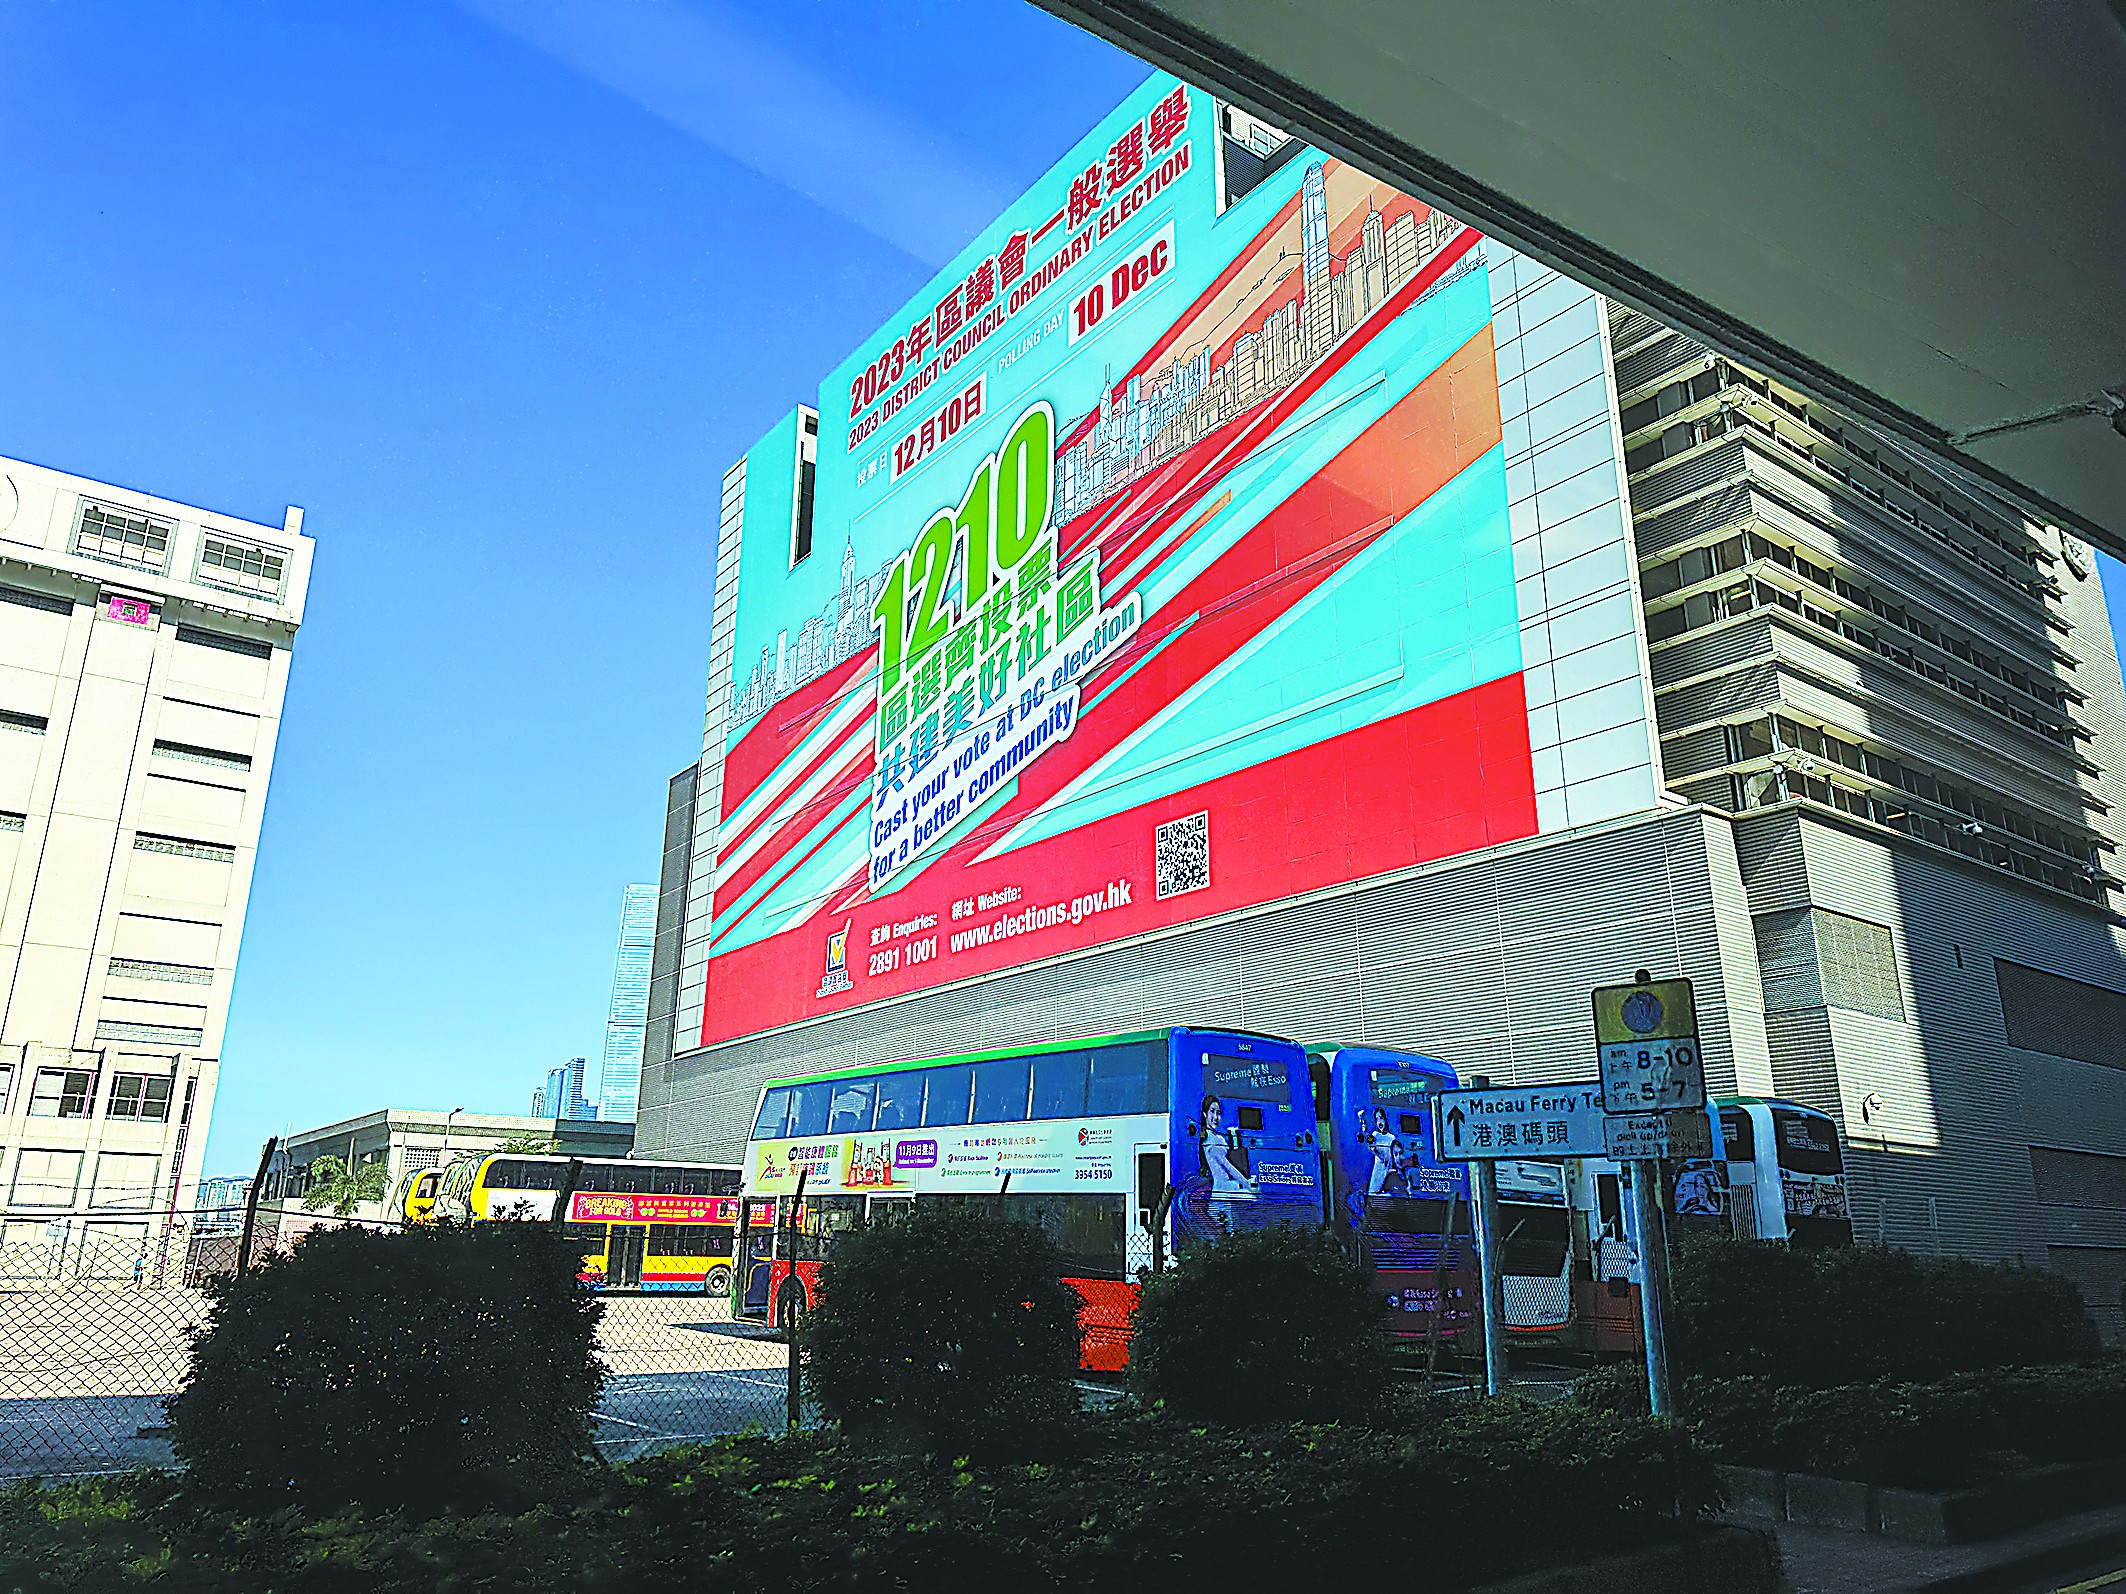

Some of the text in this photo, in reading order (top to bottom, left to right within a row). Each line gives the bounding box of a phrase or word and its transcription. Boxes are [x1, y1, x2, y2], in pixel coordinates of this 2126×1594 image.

[850, 84, 1188, 419] 2023年區議會一般選舉
[1074, 239, 1168, 336] 10 Dec
[848, 144, 1189, 451] 2023 DISTRICT COUNCIL ORDINARY ELECTION
[998, 308, 1065, 375] POLLING DAY
[895, 380, 982, 477] 12月10日
[874, 408, 1052, 698] 1210
[880, 537, 1053, 755] 區選齊投票
[876, 557, 1094, 812] 共建美好社區
[874, 600, 1134, 849] Cast your vote at DC election
[873, 694, 1075, 884] for a better community
[893, 913, 938, 939] Enquiries:
[951, 878, 1133, 954] www.elections.gov.hk
[952, 886, 1022, 921] 網址 Website:
[869, 935, 938, 977] 2891 1001
[1215, 1068, 1252, 1083] Supreme
[1638, 1047, 1693, 1069] 8-10
[1469, 1092, 1604, 1115] Macau Ferry Te
[1472, 1120, 1570, 1148] 港澳碼頭
[1075, 1169, 1113, 1180] 3954 5150
